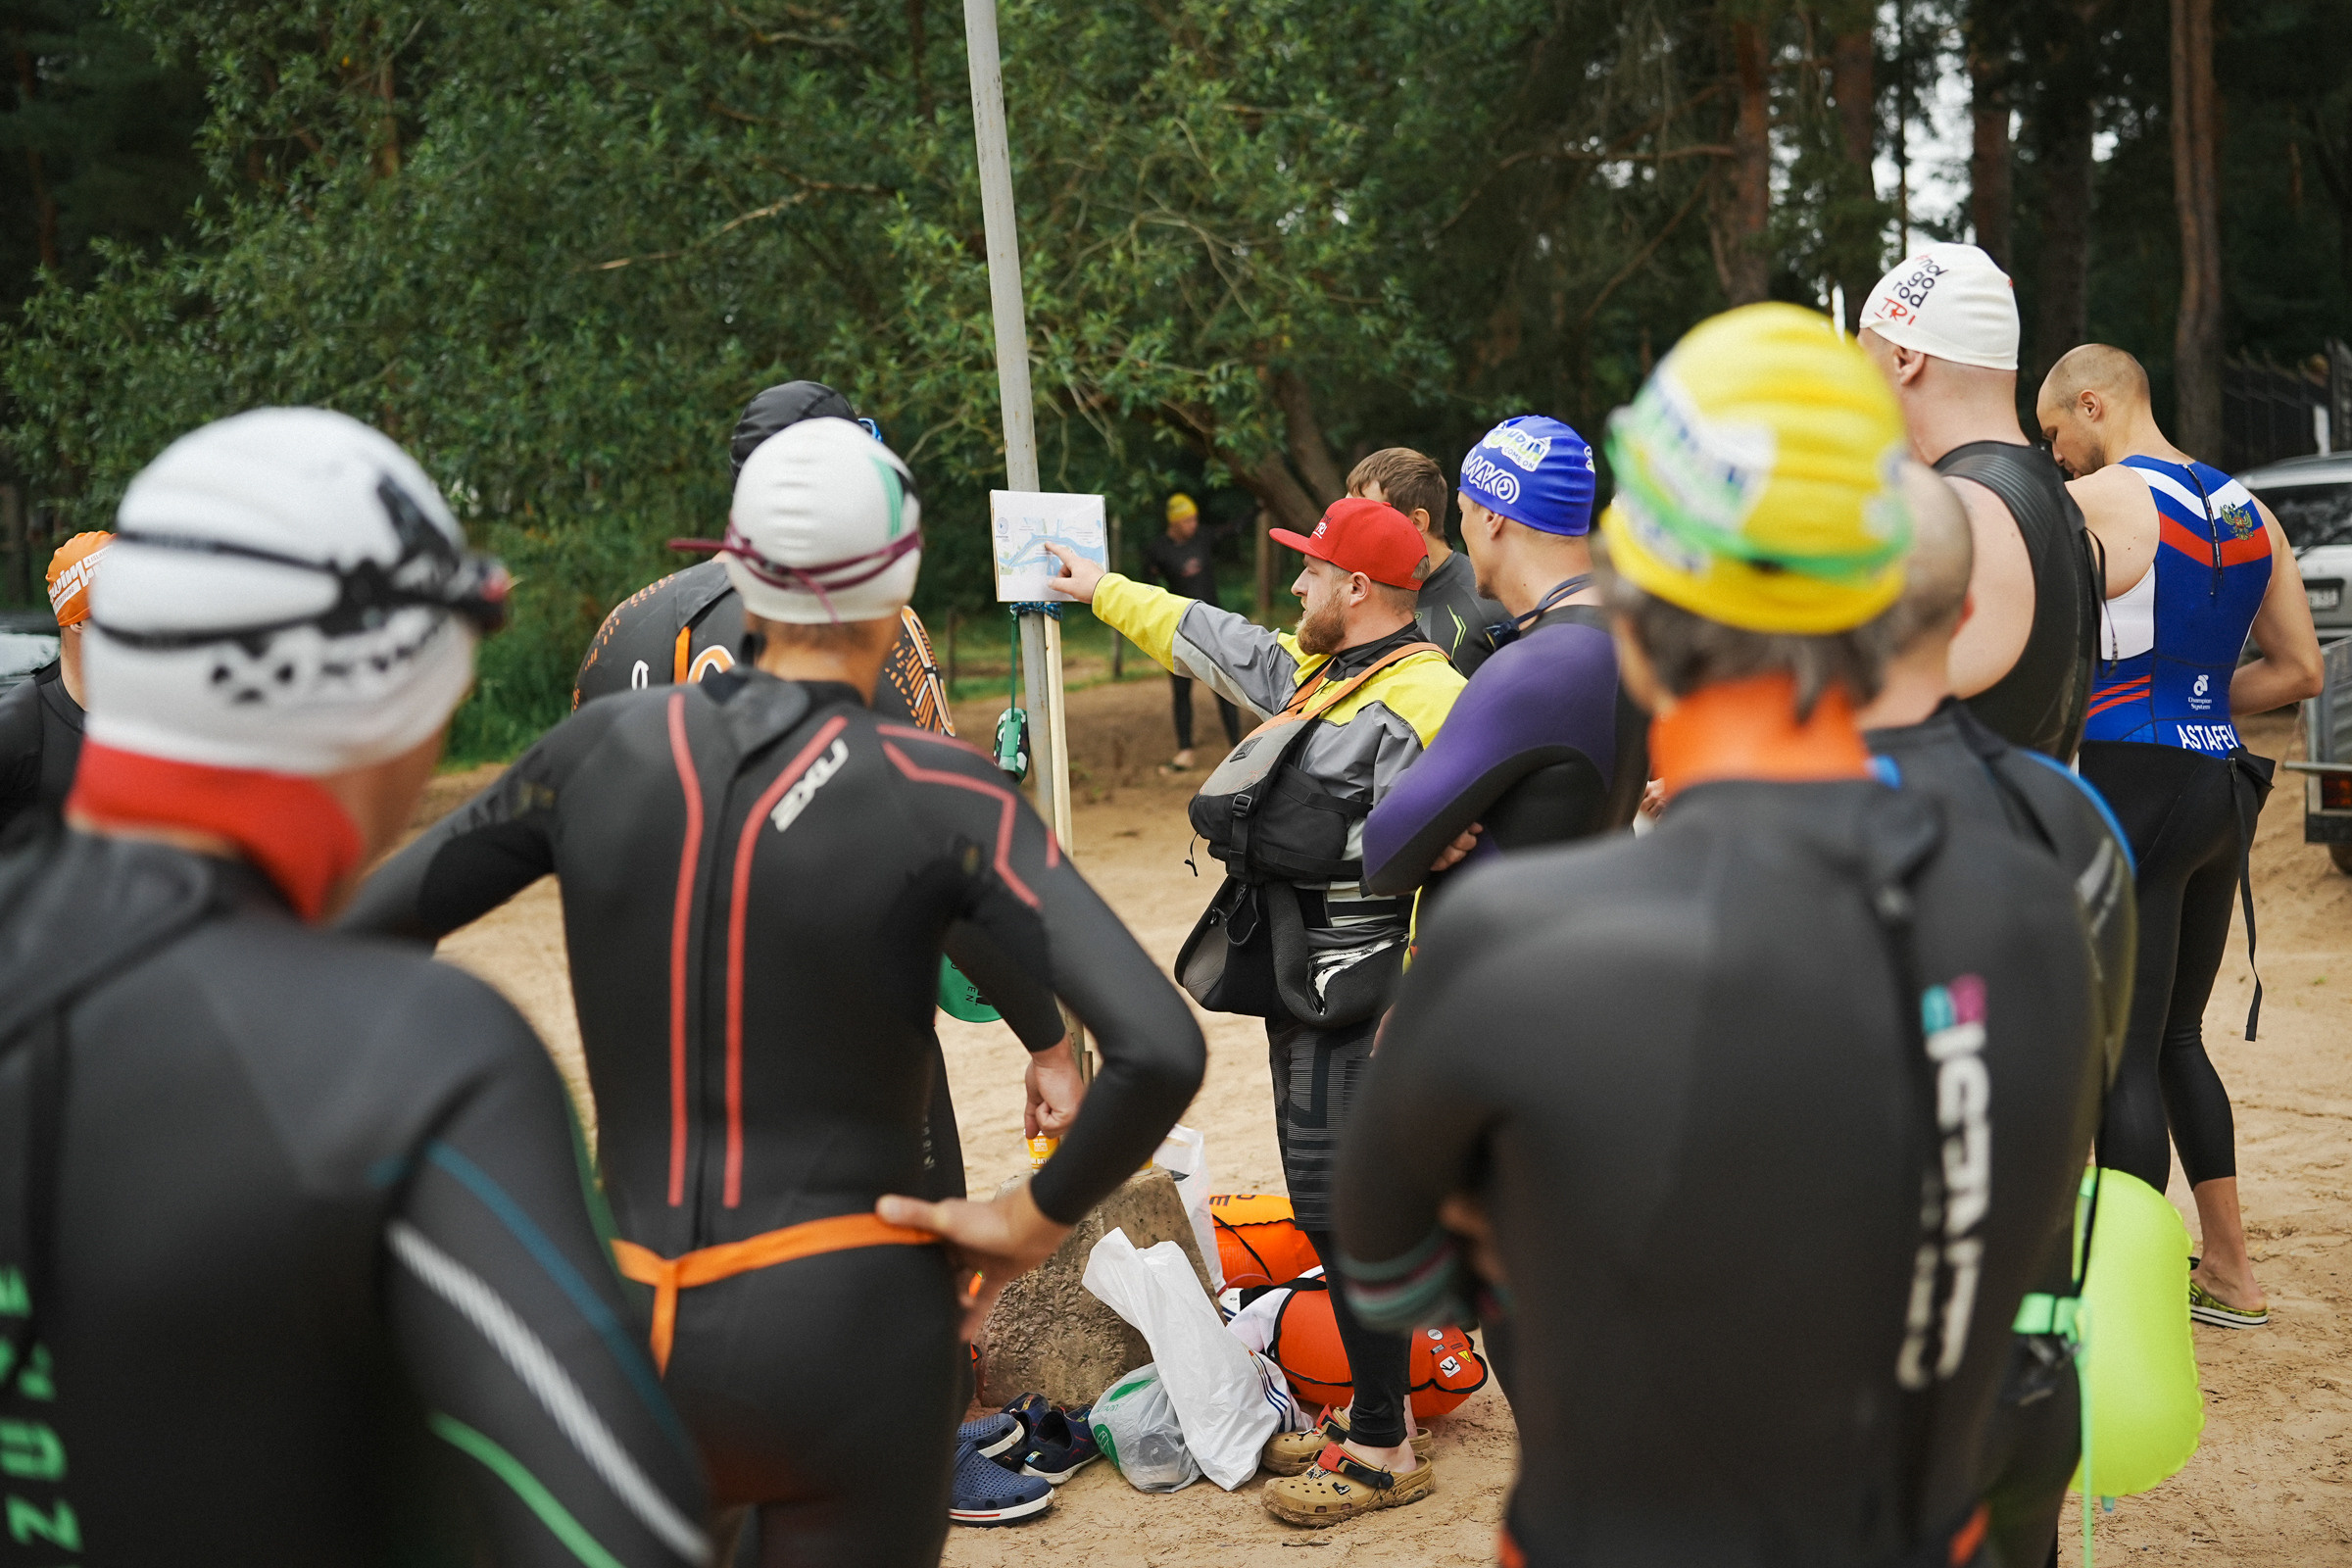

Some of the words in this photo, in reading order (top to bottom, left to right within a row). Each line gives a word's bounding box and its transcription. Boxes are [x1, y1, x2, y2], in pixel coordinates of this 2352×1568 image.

[1907, 270, 1936, 290] go
[1892, 280, 1929, 309] rod
[1522, 460, 1535, 469] ON
[2190, 703, 2211, 711] System
